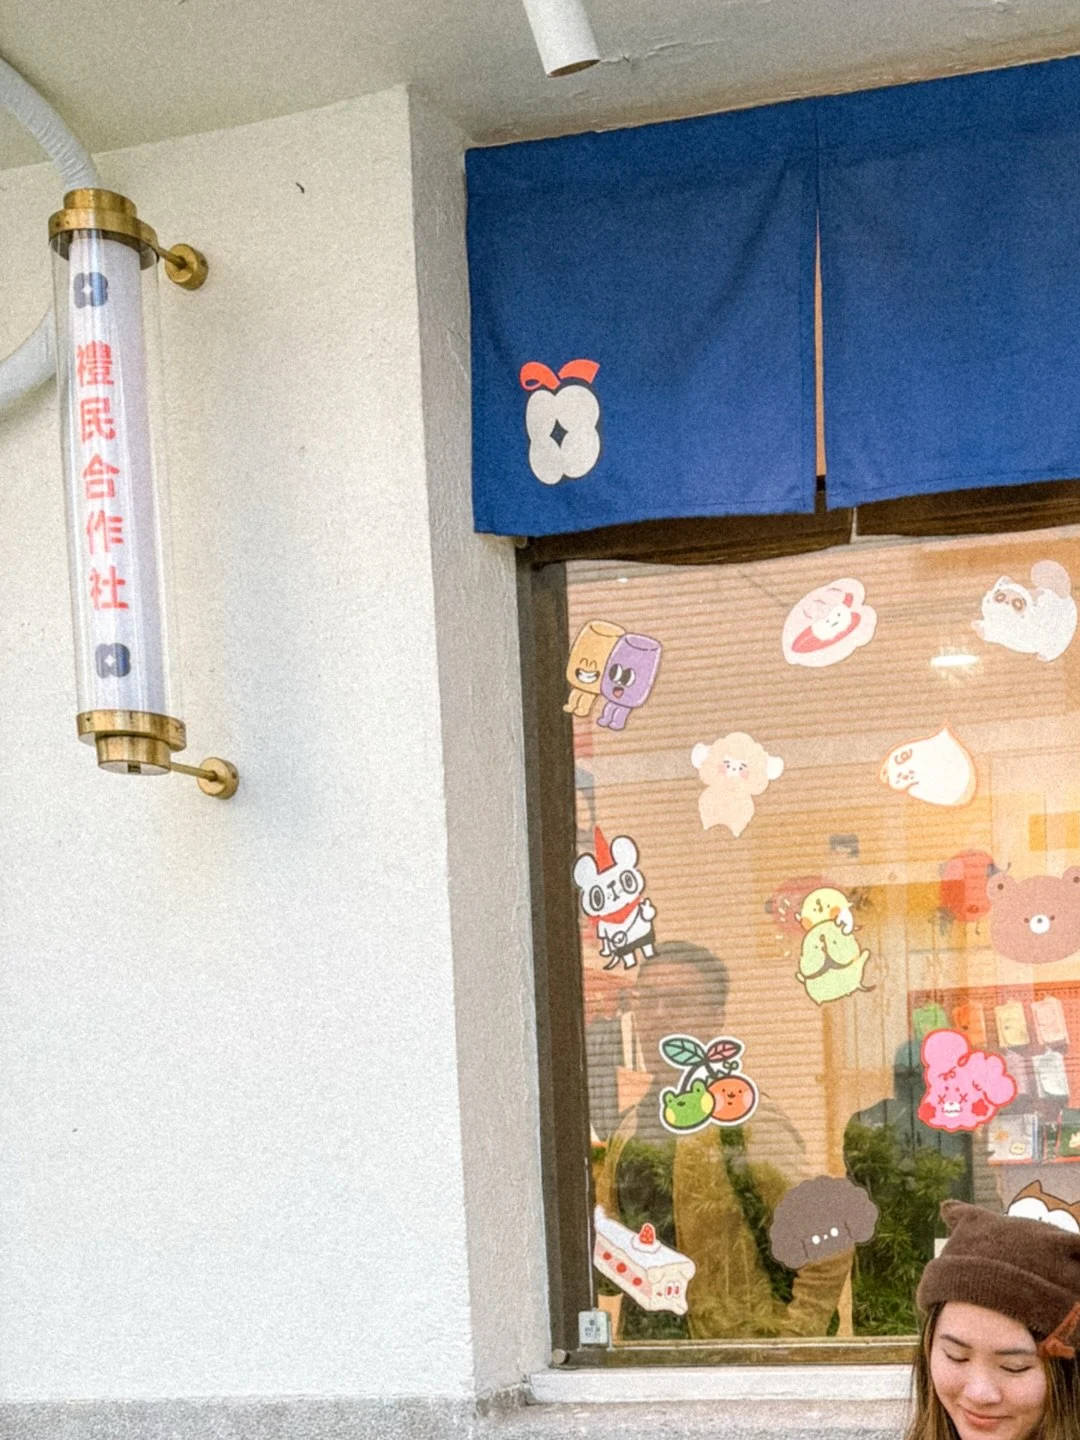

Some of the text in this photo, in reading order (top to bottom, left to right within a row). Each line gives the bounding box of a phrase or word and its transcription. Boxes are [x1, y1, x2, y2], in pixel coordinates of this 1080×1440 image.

[76, 340, 129, 611] 禮民合作社
